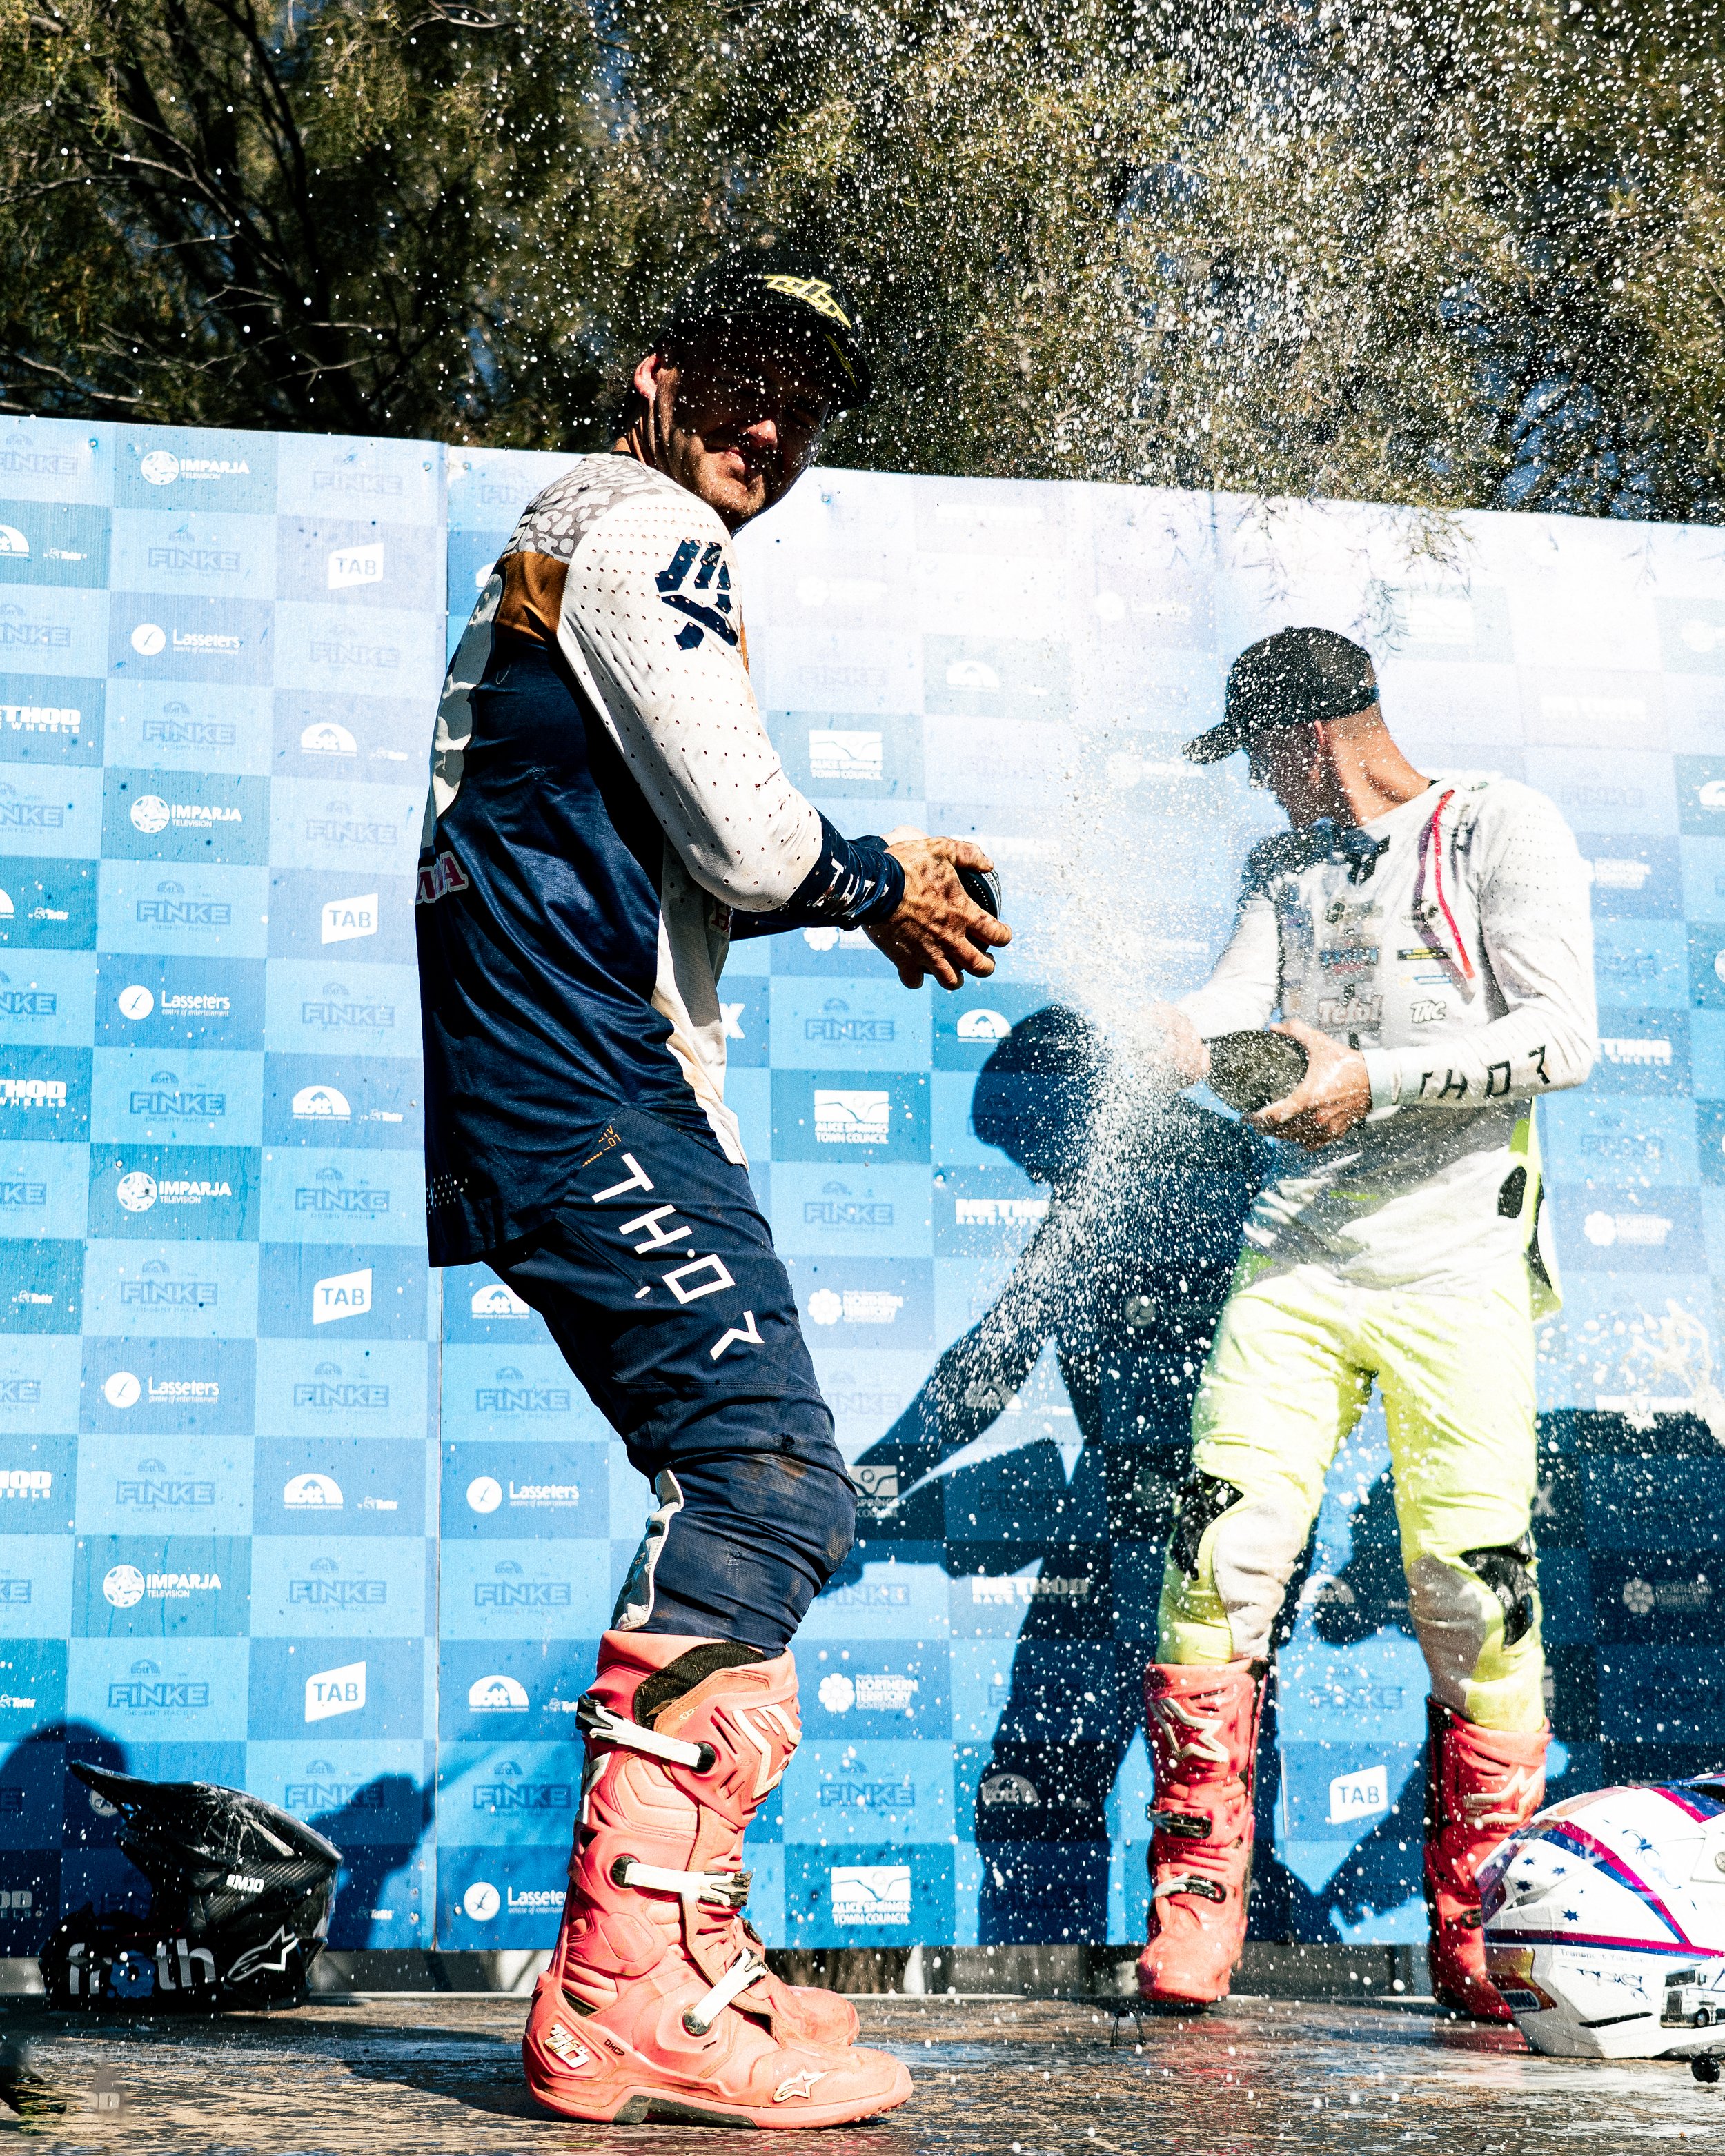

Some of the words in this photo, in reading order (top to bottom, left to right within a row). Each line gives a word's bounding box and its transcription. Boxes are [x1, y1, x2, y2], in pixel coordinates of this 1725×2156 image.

[0, 451, 77, 475] INKE
[181, 459, 250, 475] IMPARJA
[148, 548, 240, 571] FINKE
[335, 557, 376, 575] TAB
[173, 629, 240, 647] Lasseters
[0, 705, 81, 725] THOD
[12, 722, 80, 734] WHEELS
[142, 720, 236, 745] FINKE
[172, 804, 242, 822] IMPARJA
[172, 820, 213, 828] TELEVISION
[306, 820, 397, 845] FINKE
[137, 899, 231, 925] FINKE
[328, 910, 371, 928] TAB
[161, 990, 230, 1011] Lasseters
[302, 1002, 395, 1027] FINKE
[806, 1018, 894, 1041] FINKE
[1419, 1044, 1551, 1100] THOR
[130, 1089, 226, 1116] FINKE
[816, 1132, 845, 1143] TOWN
[846, 1133, 889, 1145] COUNCIL
[159, 1181, 232, 1197] IMPARJA
[295, 1187, 389, 1211] FINKE
[159, 1196, 201, 1204] TELEVISION
[804, 1202, 893, 1225] FINKE
[592, 1152, 765, 1361] THOR
[120, 1281, 217, 1306] FINKE
[321, 1287, 364, 1306] TAB
[148, 1376, 219, 1396] Lasseters
[294, 1383, 389, 1407] FINKE
[476, 1388, 571, 1412] FINKE
[824, 1392, 900, 1415] INKE
[0, 1488, 51, 1499] EELS
[116, 1481, 215, 1505] FINKE
[509, 1481, 580, 1501] Lasseters
[146, 1573, 222, 1589] IMPARJA
[972, 1576, 1089, 1595] METHOD
[147, 1589, 190, 1598] TELEVISION
[290, 1579, 386, 1604] FINKE
[474, 1583, 571, 1606] FINKE
[973, 1594, 1014, 1604] RACE
[108, 1681, 209, 1708] FINKE
[313, 1683, 359, 1701] TAB
[856, 1679, 919, 1692] NORTHERN
[856, 1690, 911, 1702] TERRITORY
[285, 1783, 384, 1808] FINKE
[473, 1783, 571, 1808] FINKE
[820, 1782, 915, 1806] FINKE
[1338, 1786, 1380, 1804] TAB
[832, 1901, 863, 1913] ALICE
[864, 1902, 911, 1913] SPRINGS
[833, 1914, 865, 1926] TOWN
[865, 1914, 911, 1926] COUNCIL
[68, 1937, 217, 1998] froth
